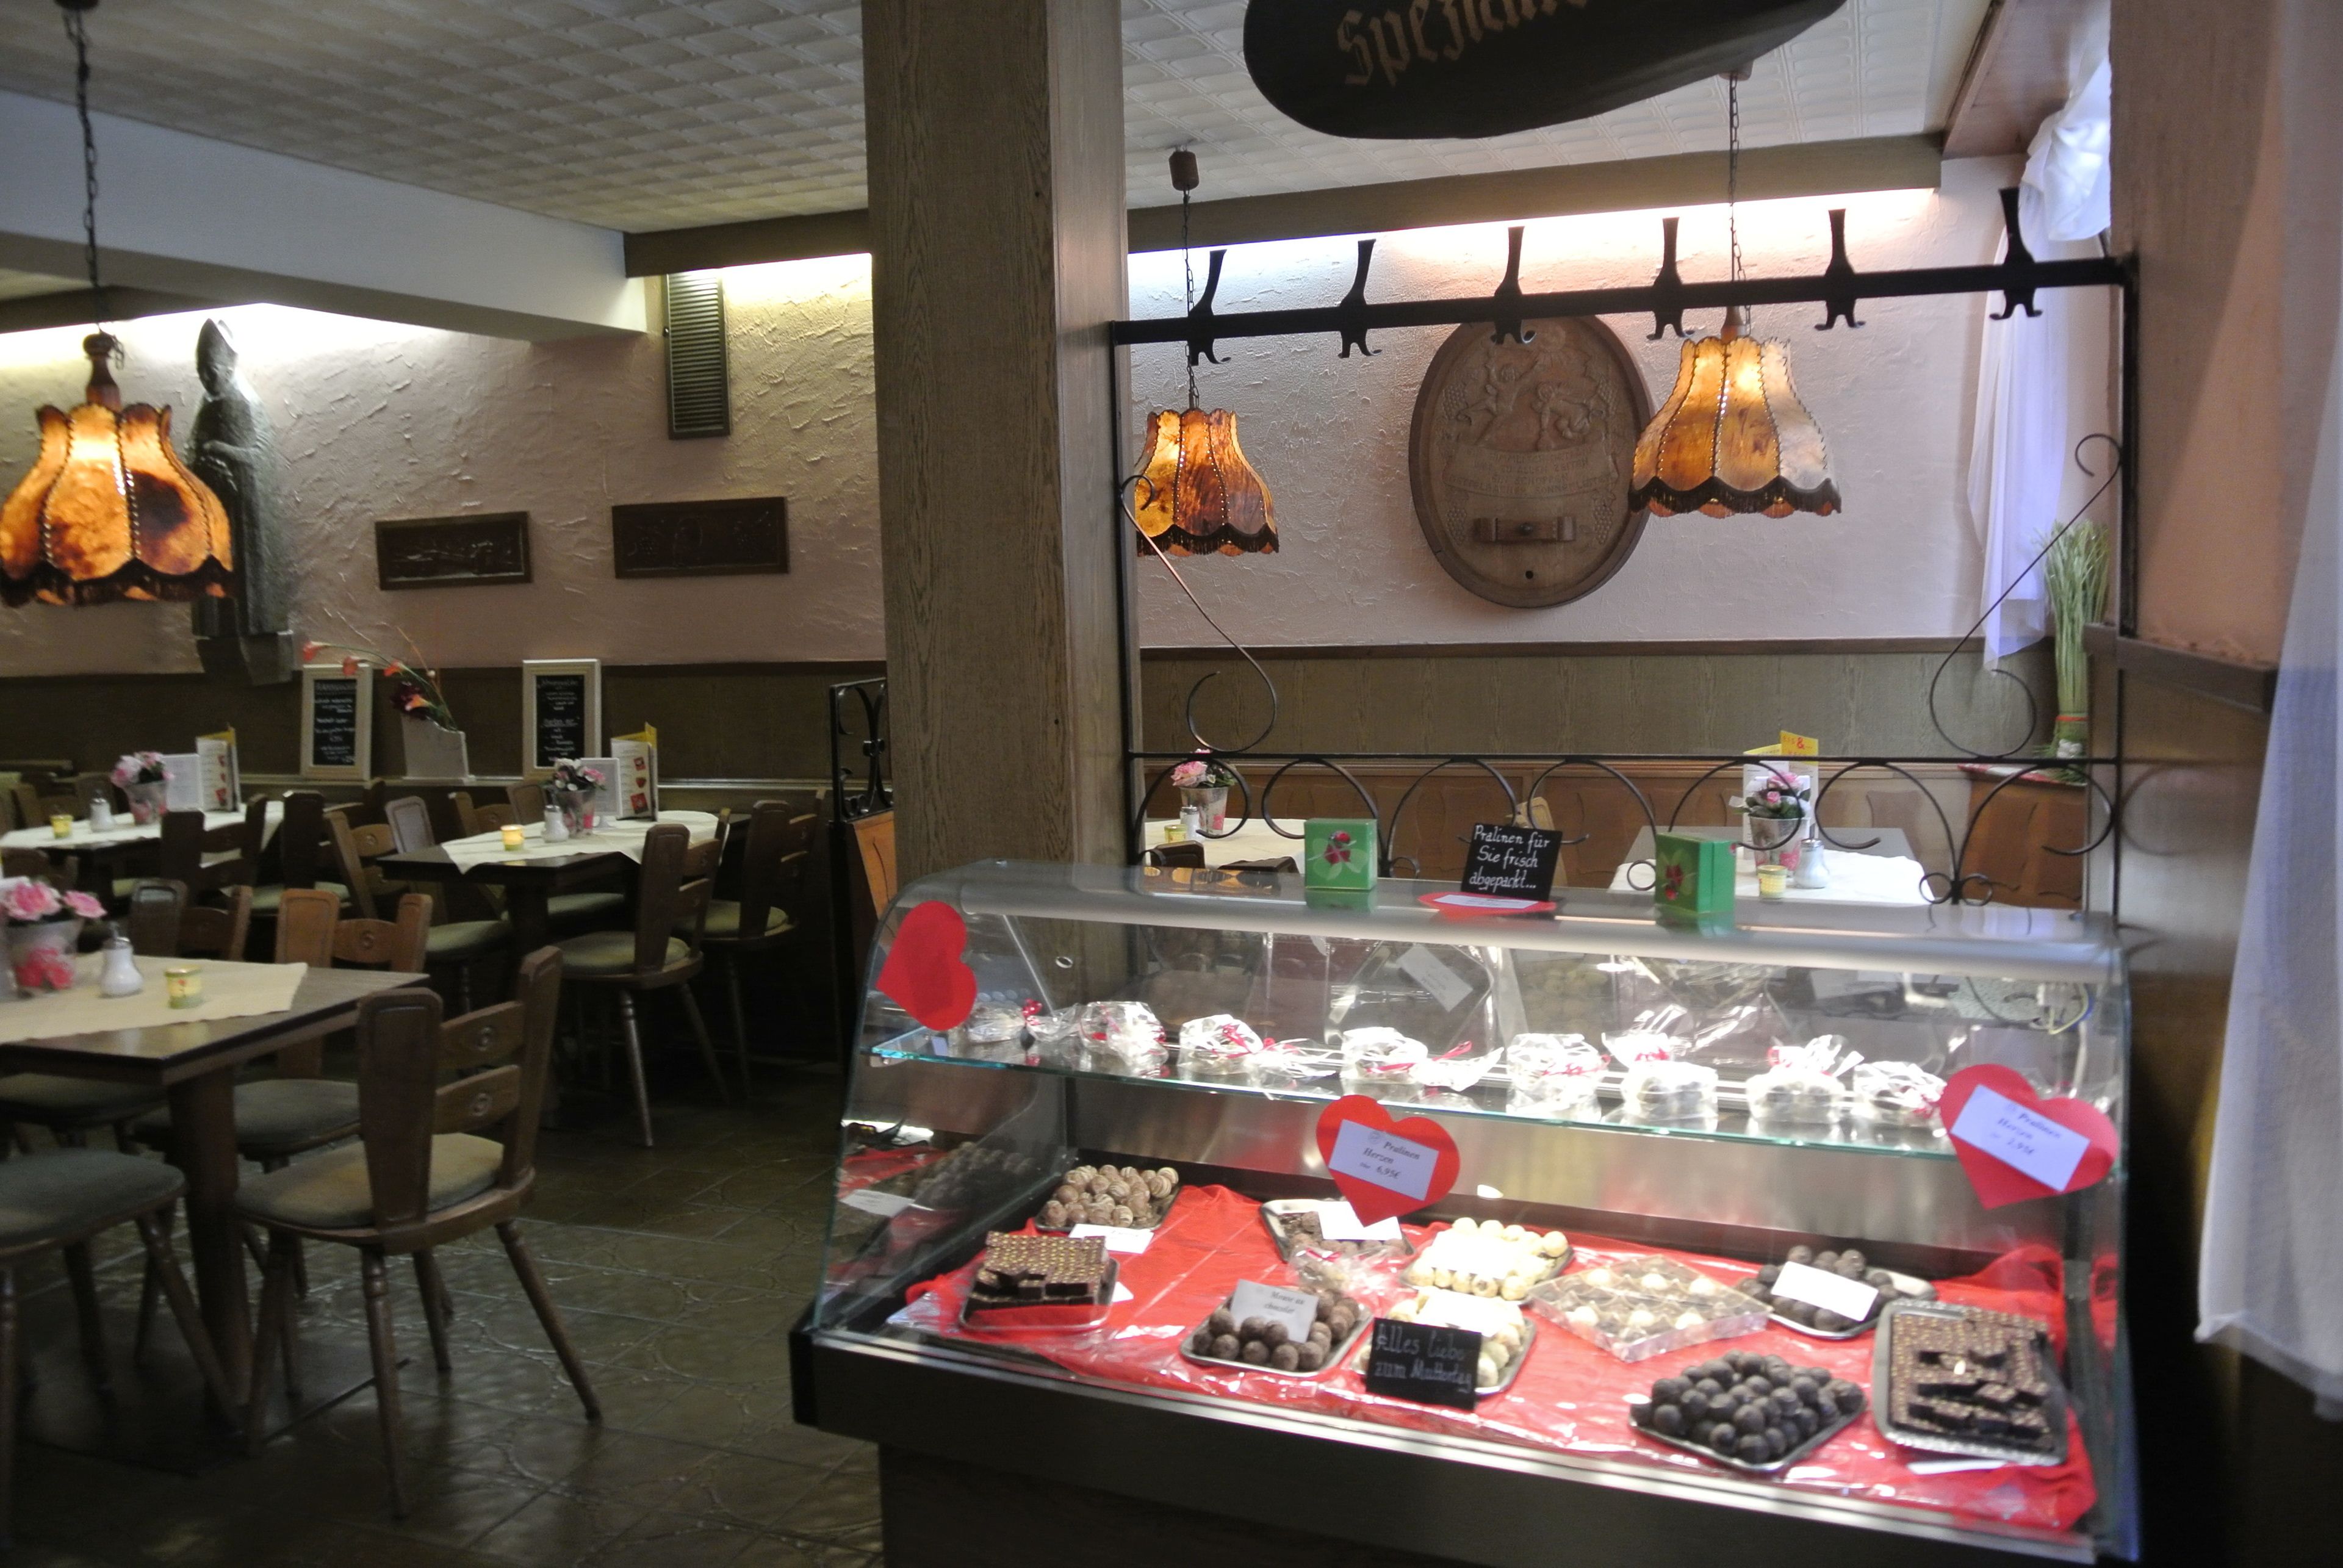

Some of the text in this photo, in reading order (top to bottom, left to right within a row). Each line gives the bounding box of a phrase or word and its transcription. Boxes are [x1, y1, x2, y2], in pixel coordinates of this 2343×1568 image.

[1474, 824, 1551, 854] Pralinen für
[1477, 845, 1538, 869] Sie frisch
[2018, 1113, 2060, 1138] Pralinen
[1363, 1147, 1394, 1164] Herzen
[1383, 1141, 1420, 1160] Pralinen
[1374, 1323, 1420, 1355] Alles
[1374, 1361, 1407, 1379] zum
